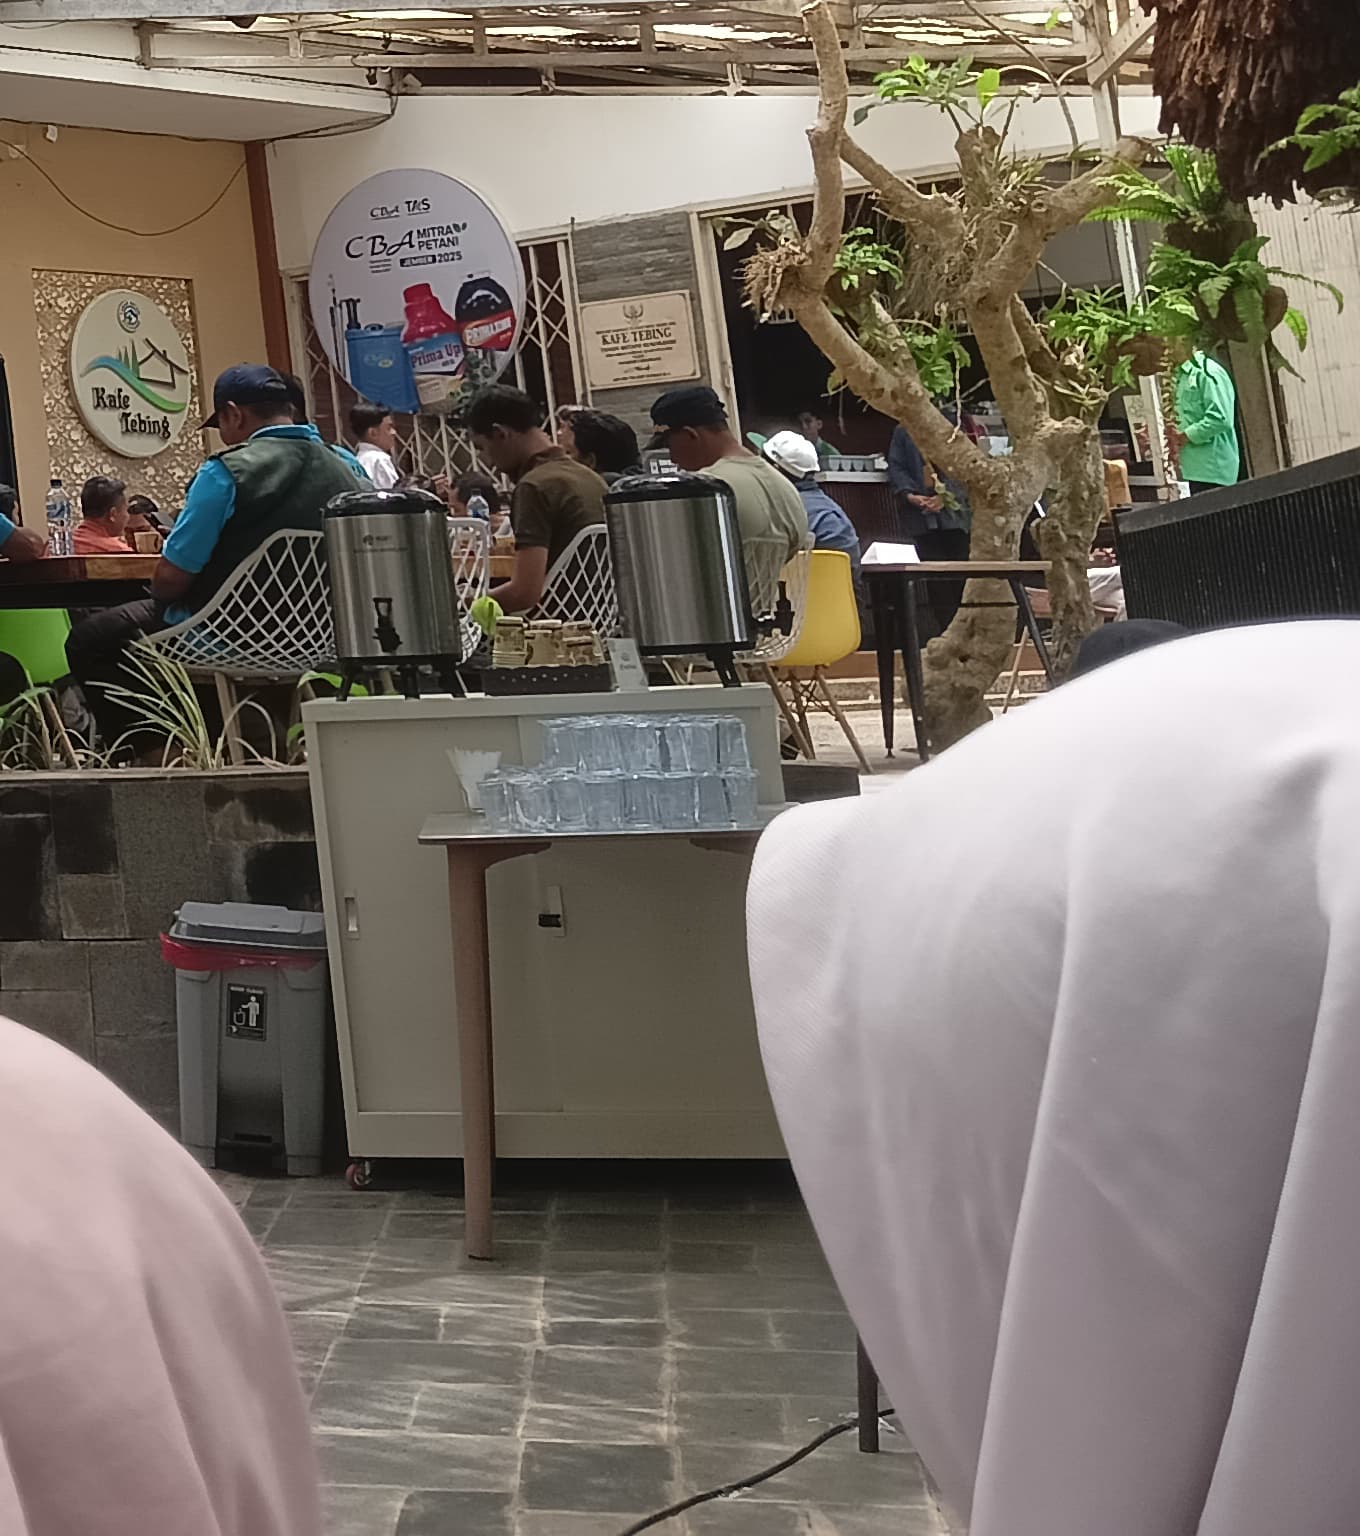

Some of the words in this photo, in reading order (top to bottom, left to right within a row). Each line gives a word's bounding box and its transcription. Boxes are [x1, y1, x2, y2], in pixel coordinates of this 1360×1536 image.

[345, 231, 416, 259] CBA
[416, 225, 454, 239] MITRA
[418, 236, 459, 250] PETANI
[438, 251, 462, 263] 2025
[601, 333, 630, 345] KAFE
[631, 327, 672, 343] TEBING
[410, 350, 443, 368] Prima
[444, 344, 461, 358] Up
[92, 387, 130, 409] Kafe
[121, 412, 171, 440] Tebing
